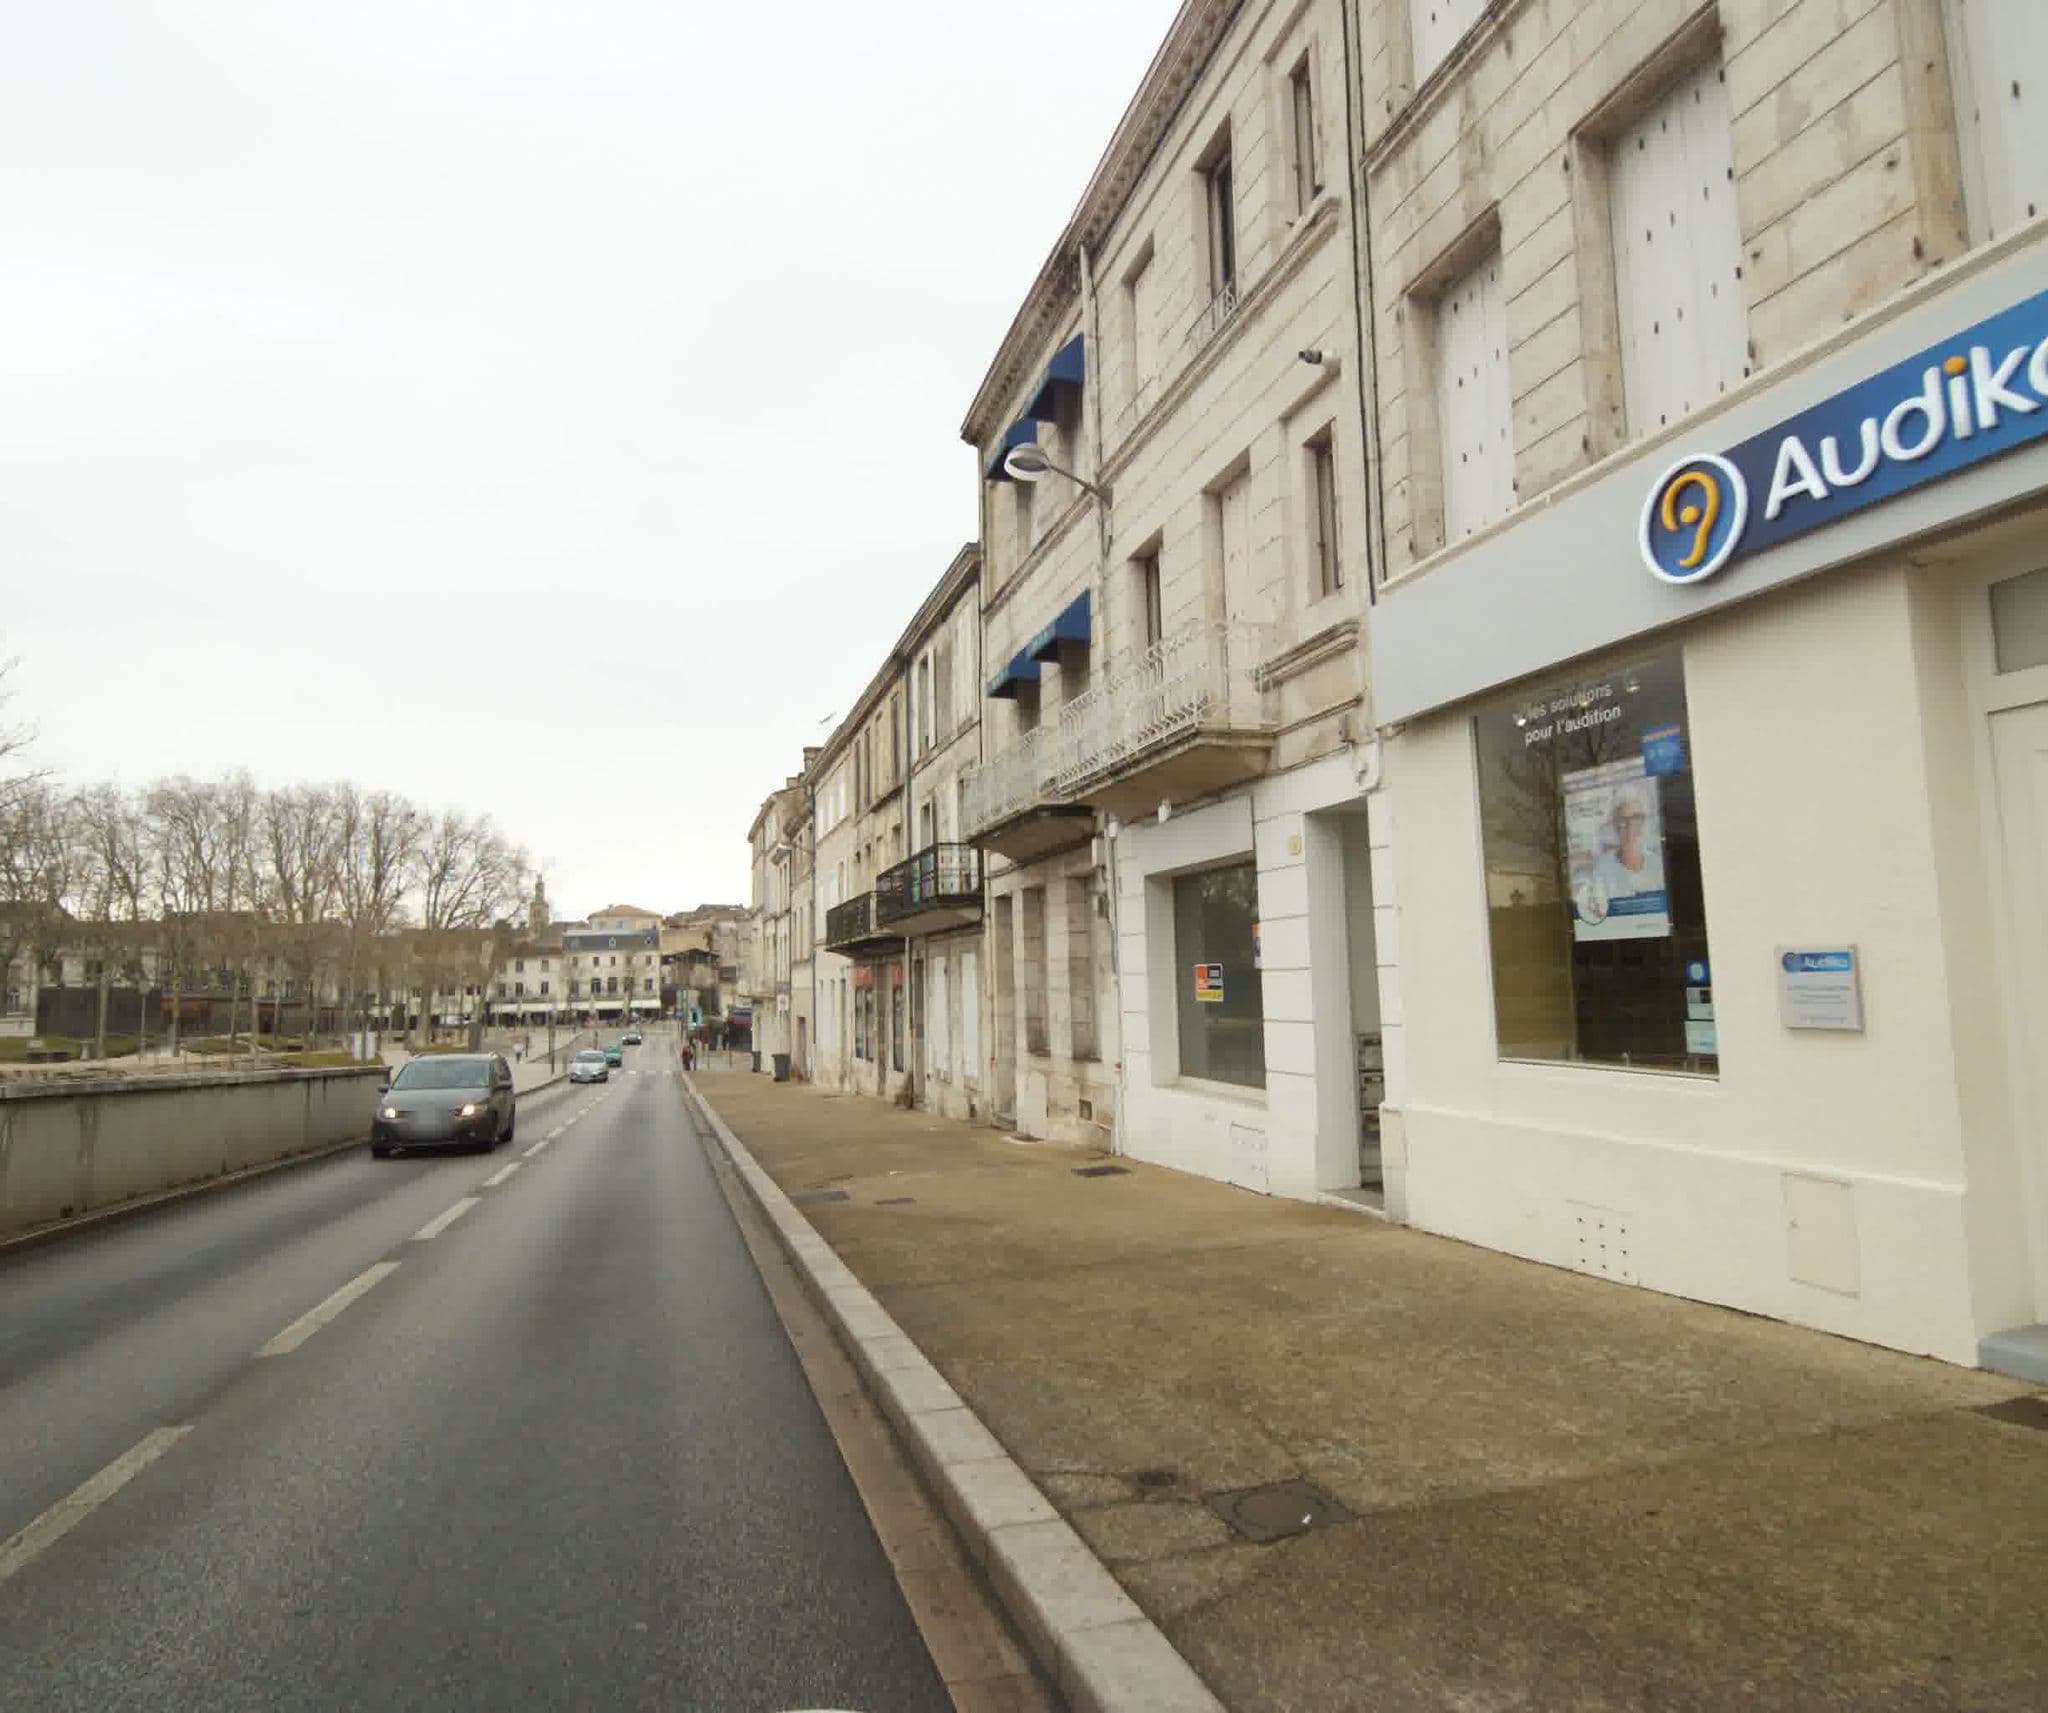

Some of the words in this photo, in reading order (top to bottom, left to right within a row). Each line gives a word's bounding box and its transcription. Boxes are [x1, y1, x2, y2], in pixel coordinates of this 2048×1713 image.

[1551, 684, 1614, 713] solutions
[1525, 725, 1554, 748] pour
[1556, 705, 1622, 735] l'audition
